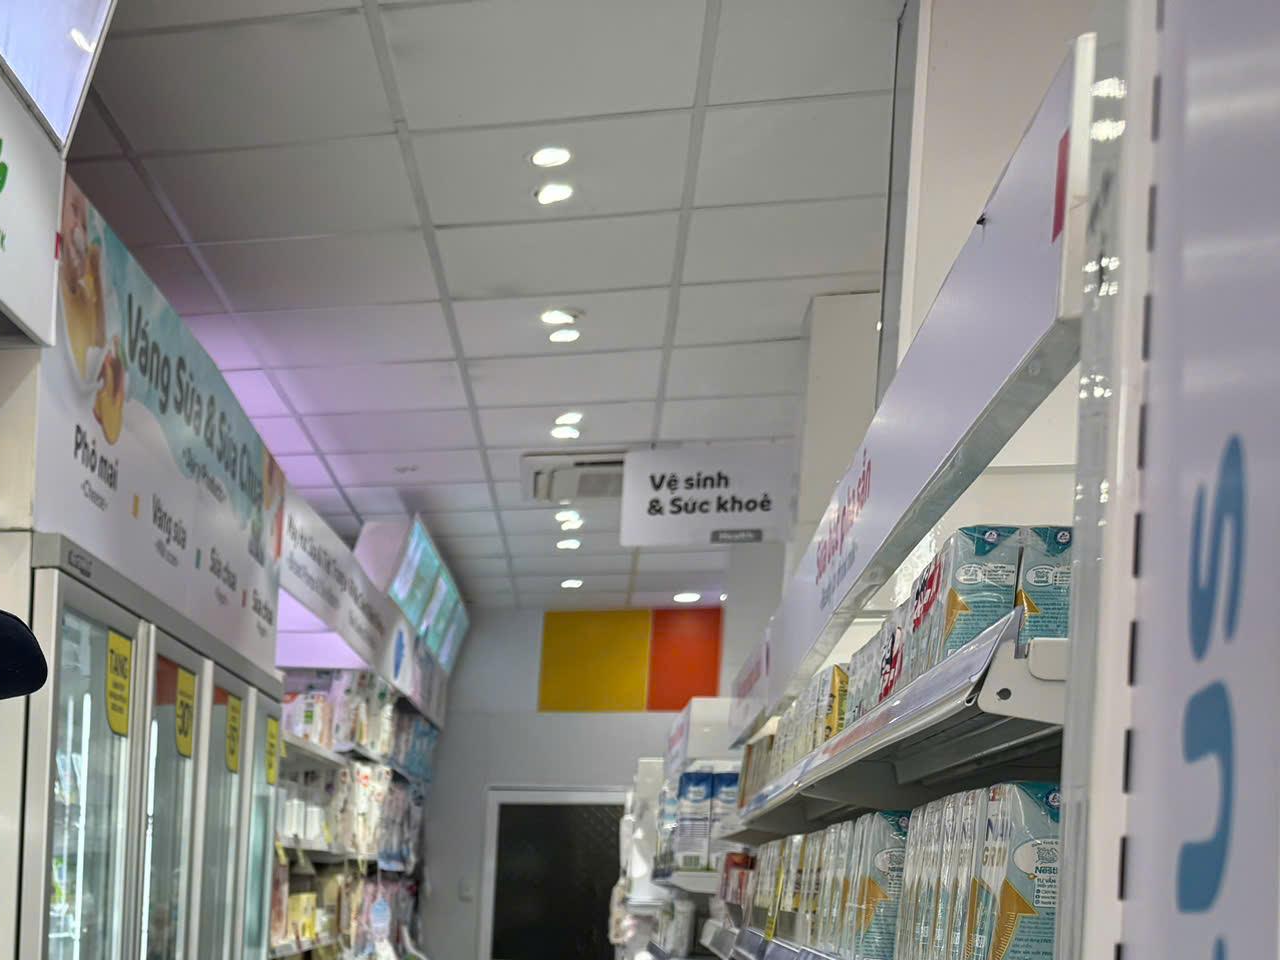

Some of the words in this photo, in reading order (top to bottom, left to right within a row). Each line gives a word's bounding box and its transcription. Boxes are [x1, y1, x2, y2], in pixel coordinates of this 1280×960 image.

[649, 473, 679, 495] Vệ
[683, 471, 730, 491] sinh
[647, 498, 664, 516] &
[669, 495, 711, 515] Sức
[716, 492, 773, 513] khoẻ
[1034, 865, 1058, 875] Nest
